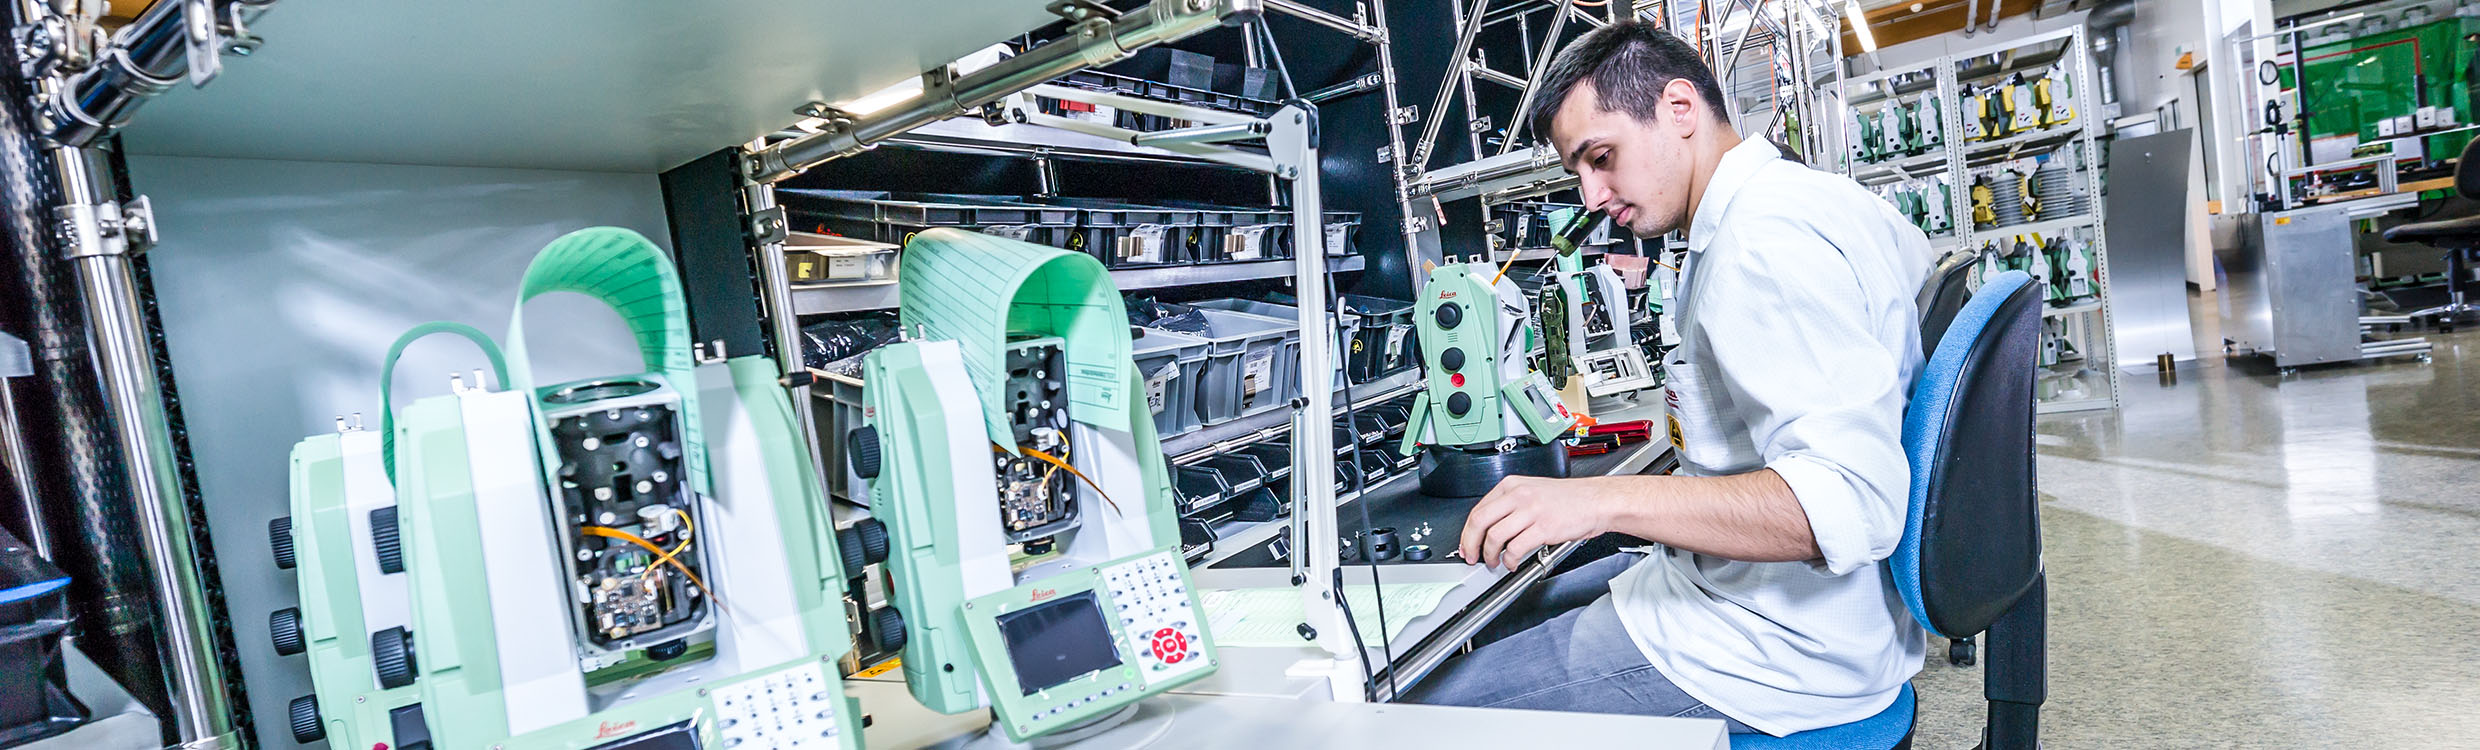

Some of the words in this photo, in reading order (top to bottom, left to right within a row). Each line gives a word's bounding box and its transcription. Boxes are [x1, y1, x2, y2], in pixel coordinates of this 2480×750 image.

[1438, 289, 1457, 300] Leica
[1029, 588, 1057, 602] Leica
[594, 720, 636, 739] Leica
